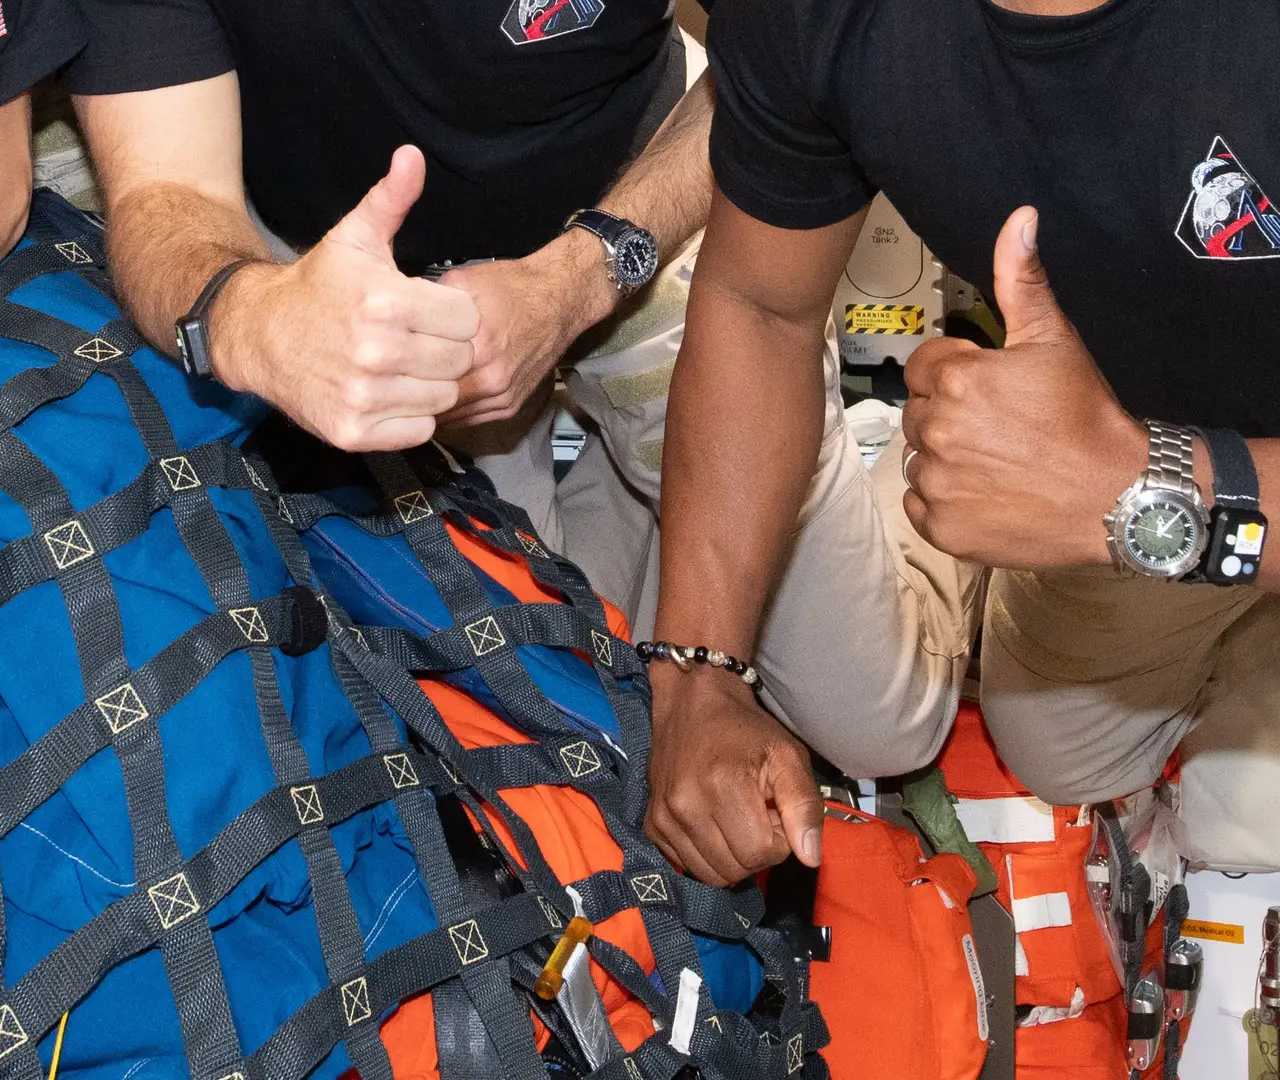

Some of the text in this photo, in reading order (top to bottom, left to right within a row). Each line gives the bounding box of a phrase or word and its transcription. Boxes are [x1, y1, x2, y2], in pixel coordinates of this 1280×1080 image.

[870, 235, 900, 244] Tank 2
[1199, 926, 1224, 936] Medical
[965, 940, 985, 999] Mooring
